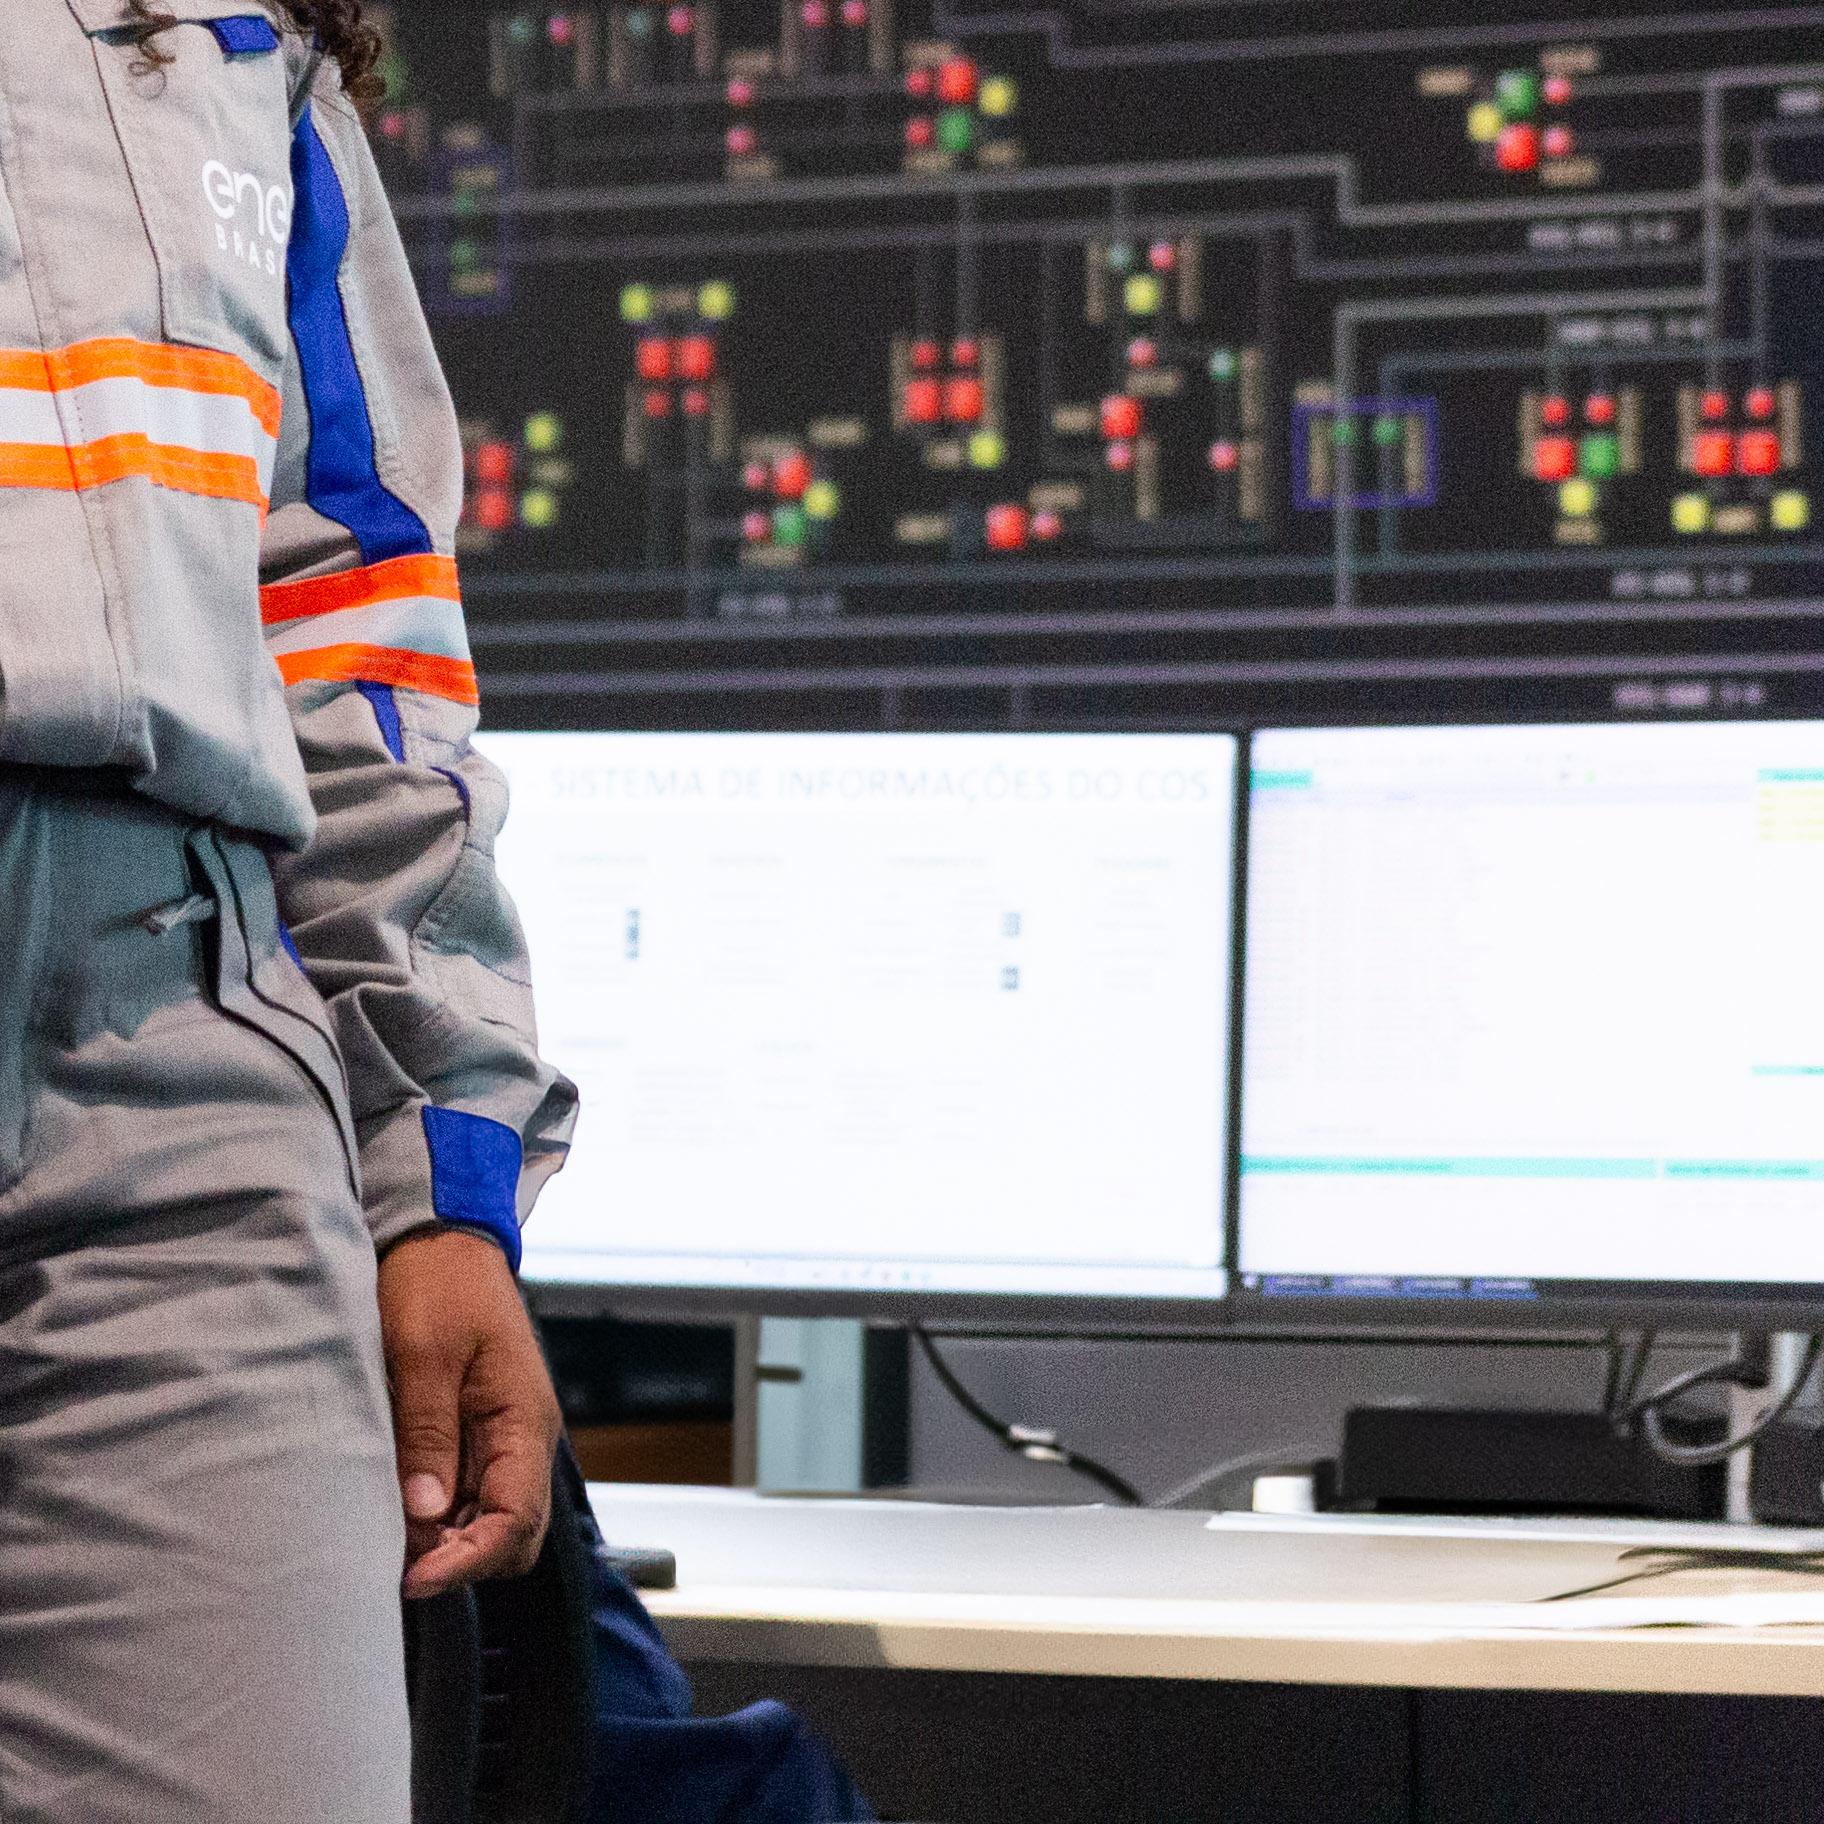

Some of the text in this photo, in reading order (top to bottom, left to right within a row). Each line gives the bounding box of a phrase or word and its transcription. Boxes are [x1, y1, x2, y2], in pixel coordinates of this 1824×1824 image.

[201, 159, 295, 245] ene
[214, 222, 284, 276] BRAS
[551, 766, 704, 798] SISTEMA
[718, 767, 762, 798] DE
[778, 761, 1053, 805] INFORMAÇÕES
[1067, 768, 1123, 800] DO
[1137, 768, 1211, 802] COS
